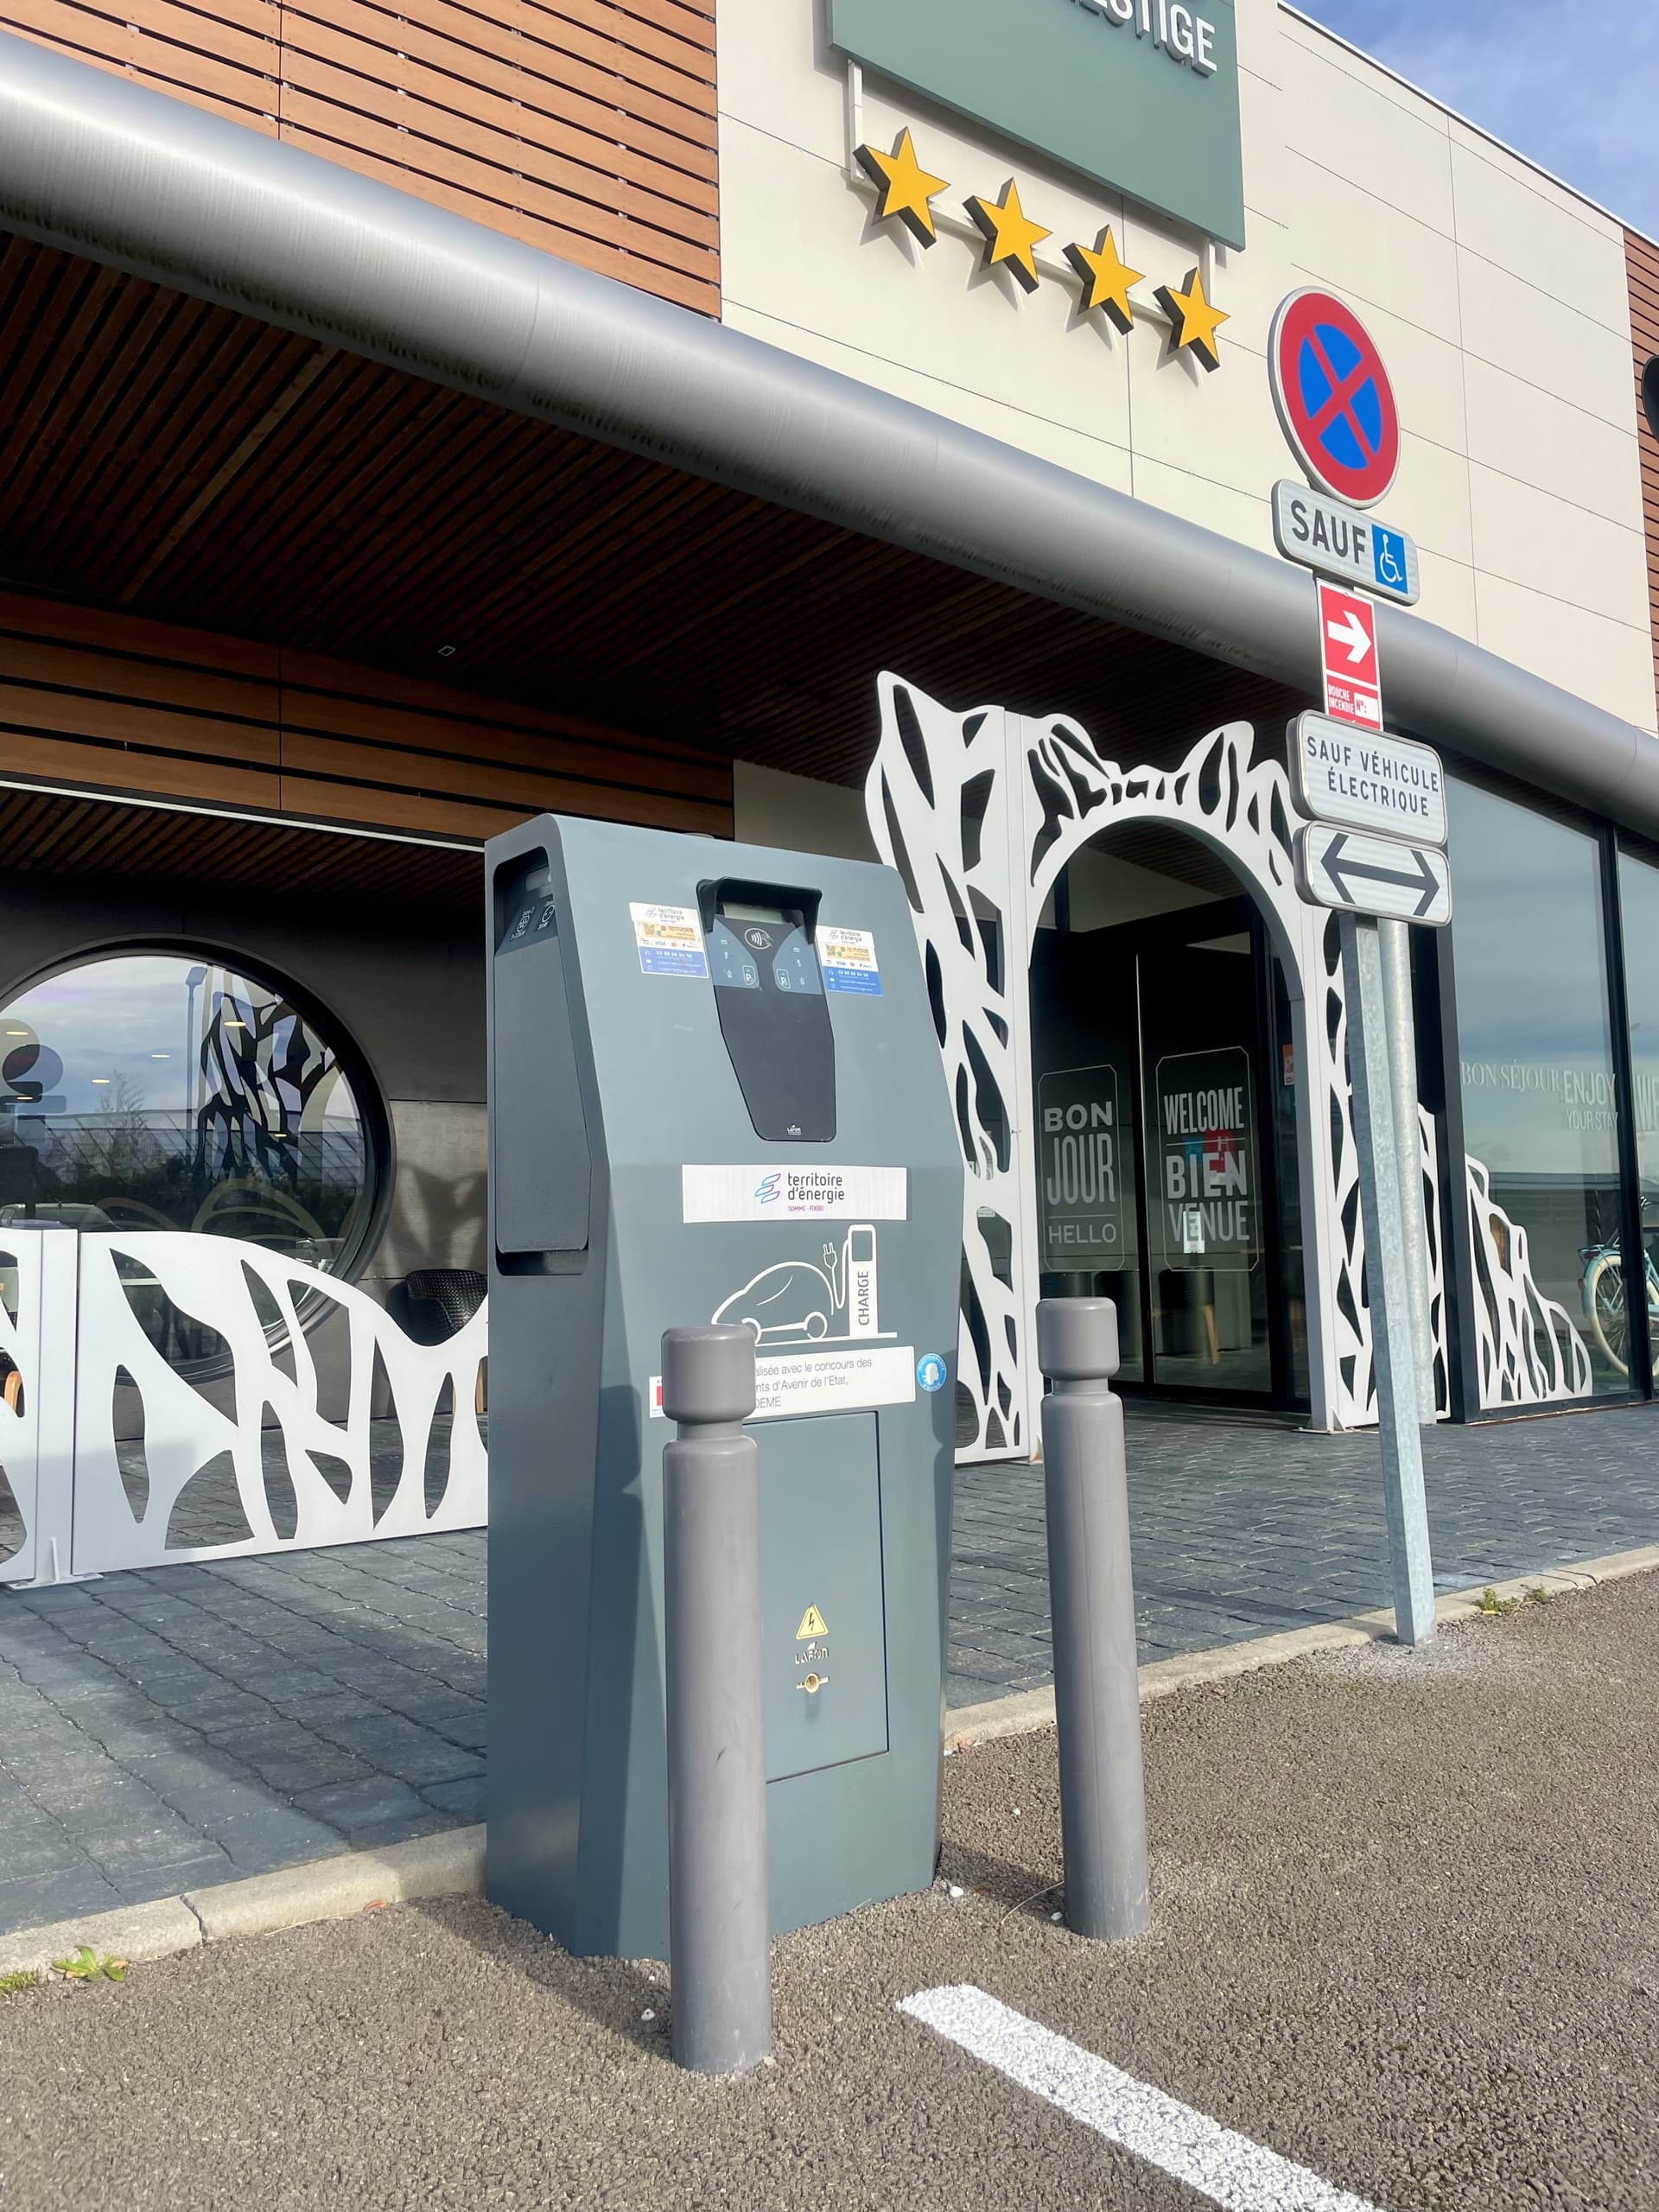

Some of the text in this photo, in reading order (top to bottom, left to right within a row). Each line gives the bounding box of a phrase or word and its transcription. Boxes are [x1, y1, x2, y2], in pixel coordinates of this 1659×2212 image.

[1290, 499, 1366, 564] SAUF
[1327, 683, 1351, 702] BOUCHE
[1328, 696, 1355, 715] INCENDIE
[1307, 735, 1439, 792] SAUF VÉHICULE
[1328, 766, 1429, 817] ÉLECTRIQUE
[1460, 1058, 1616, 1105] BON SÉJOUR ENJOY
[1044, 1101, 1113, 1132] BON
[1164, 1087, 1244, 1135] WELCOME
[1566, 1109, 1618, 1131] YOUR STAY
[787, 1173, 842, 1186] territoire
[1046, 1133, 1116, 1205] JOUR
[1166, 1150, 1248, 1199] BIEN
[787, 1186, 845, 1204] d'énergie
[1048, 1223, 1116, 1244] HELLO
[1168, 1200, 1250, 1243] VENUE
[858, 1270, 870, 1326] CHARGE
[755, 1357, 872, 1376] alisée avec le concours des
[772, 1378, 809, 1391] d'Avenir
[810, 1376, 823, 1388] de
[755, 1396, 782, 1408] DEME
